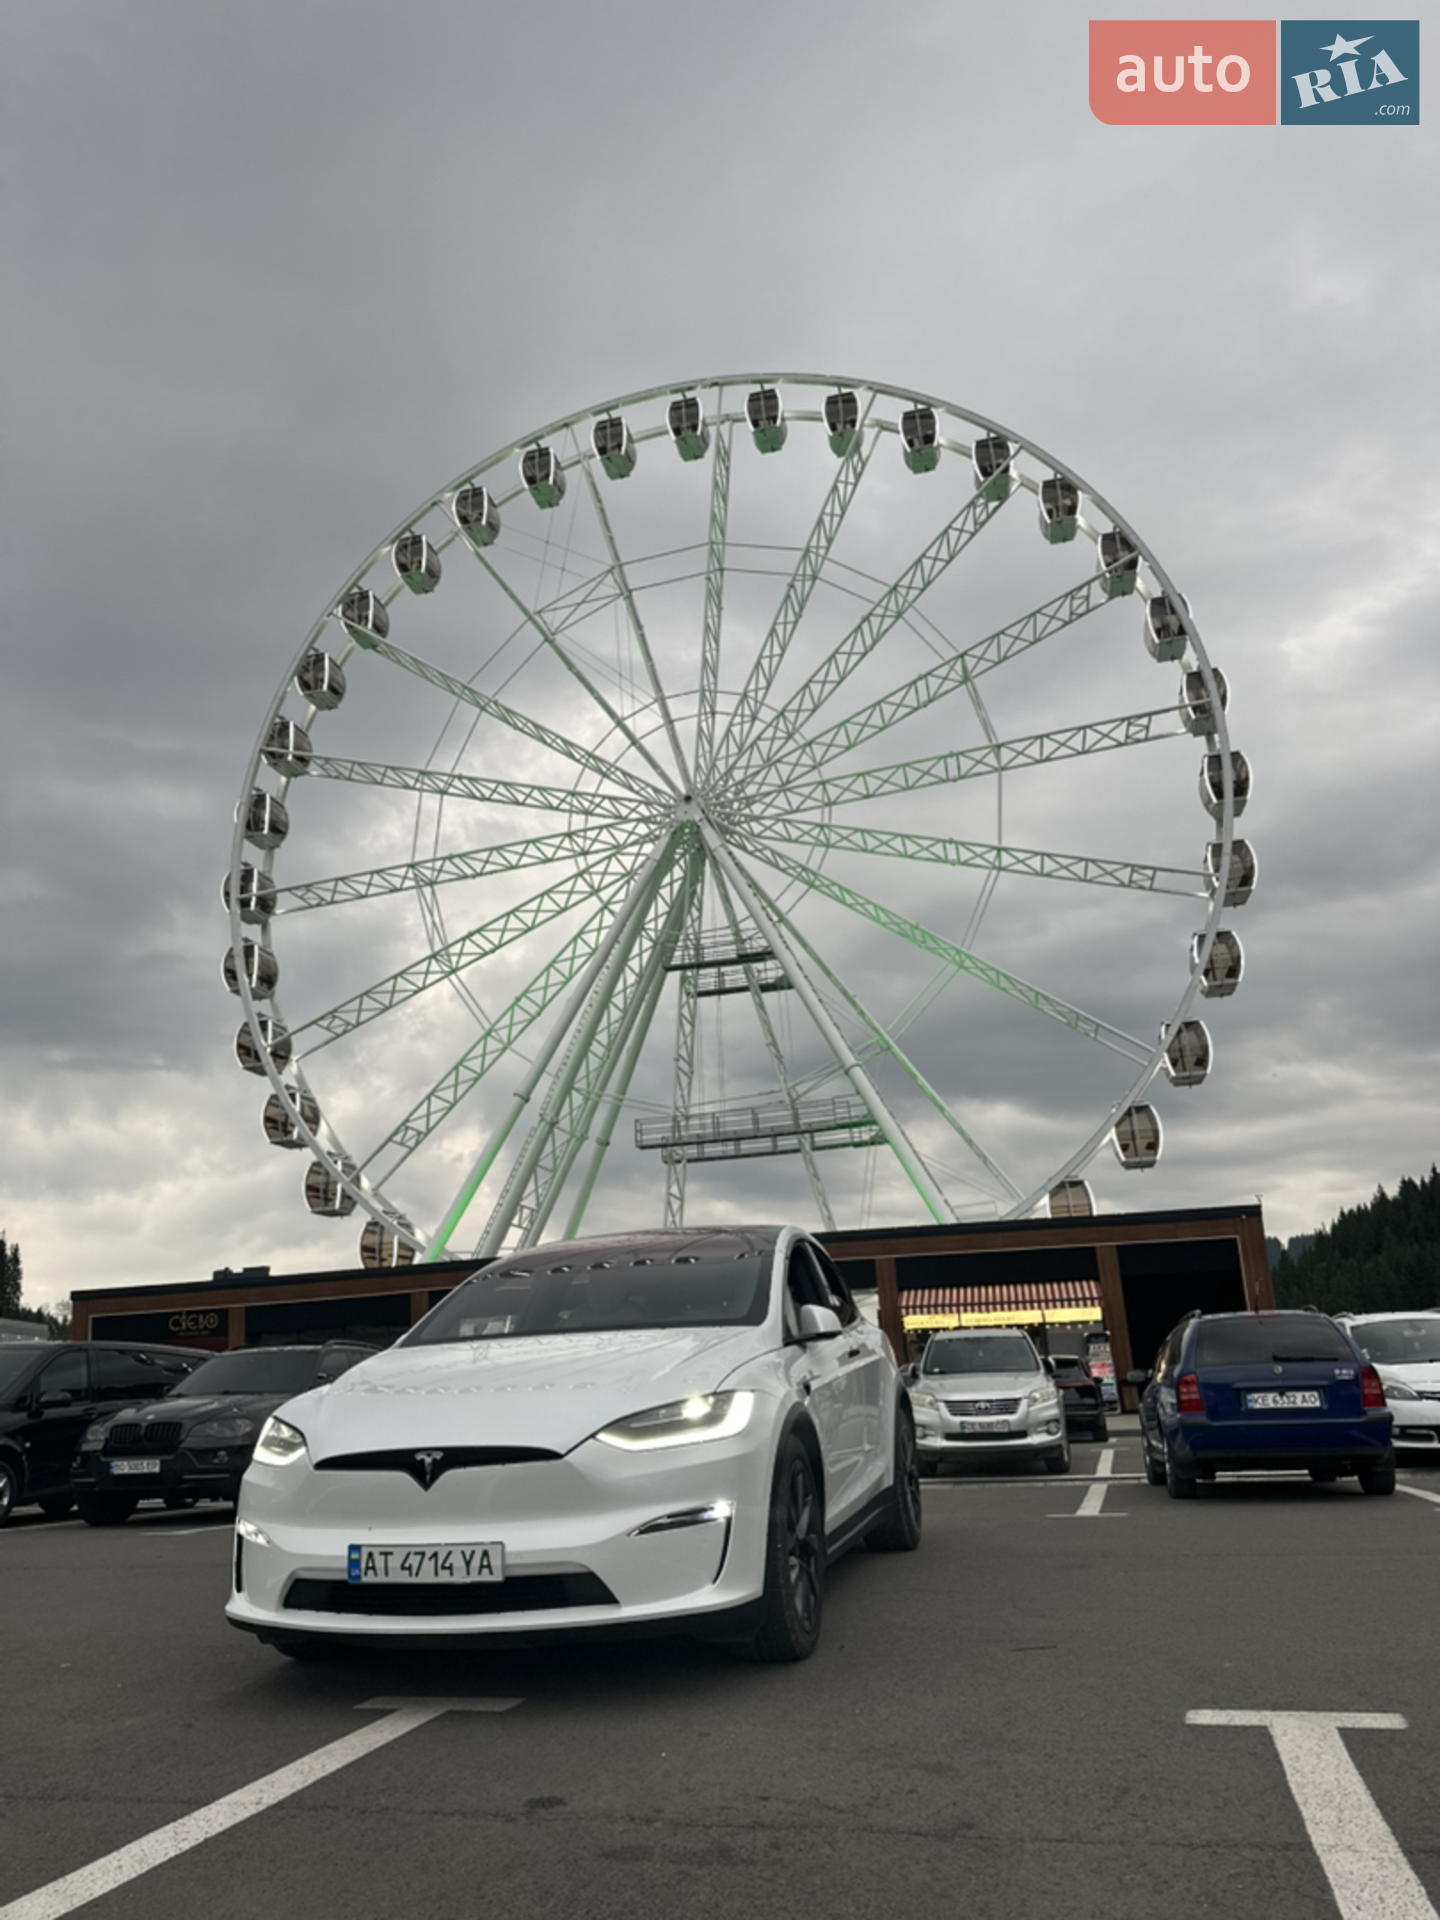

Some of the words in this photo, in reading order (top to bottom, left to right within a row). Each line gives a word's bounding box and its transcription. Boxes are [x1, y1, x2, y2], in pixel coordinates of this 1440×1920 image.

[364, 1551, 394, 1578] AT
[400, 1549, 454, 1578] 4714
[460, 1549, 494, 1576] YA
